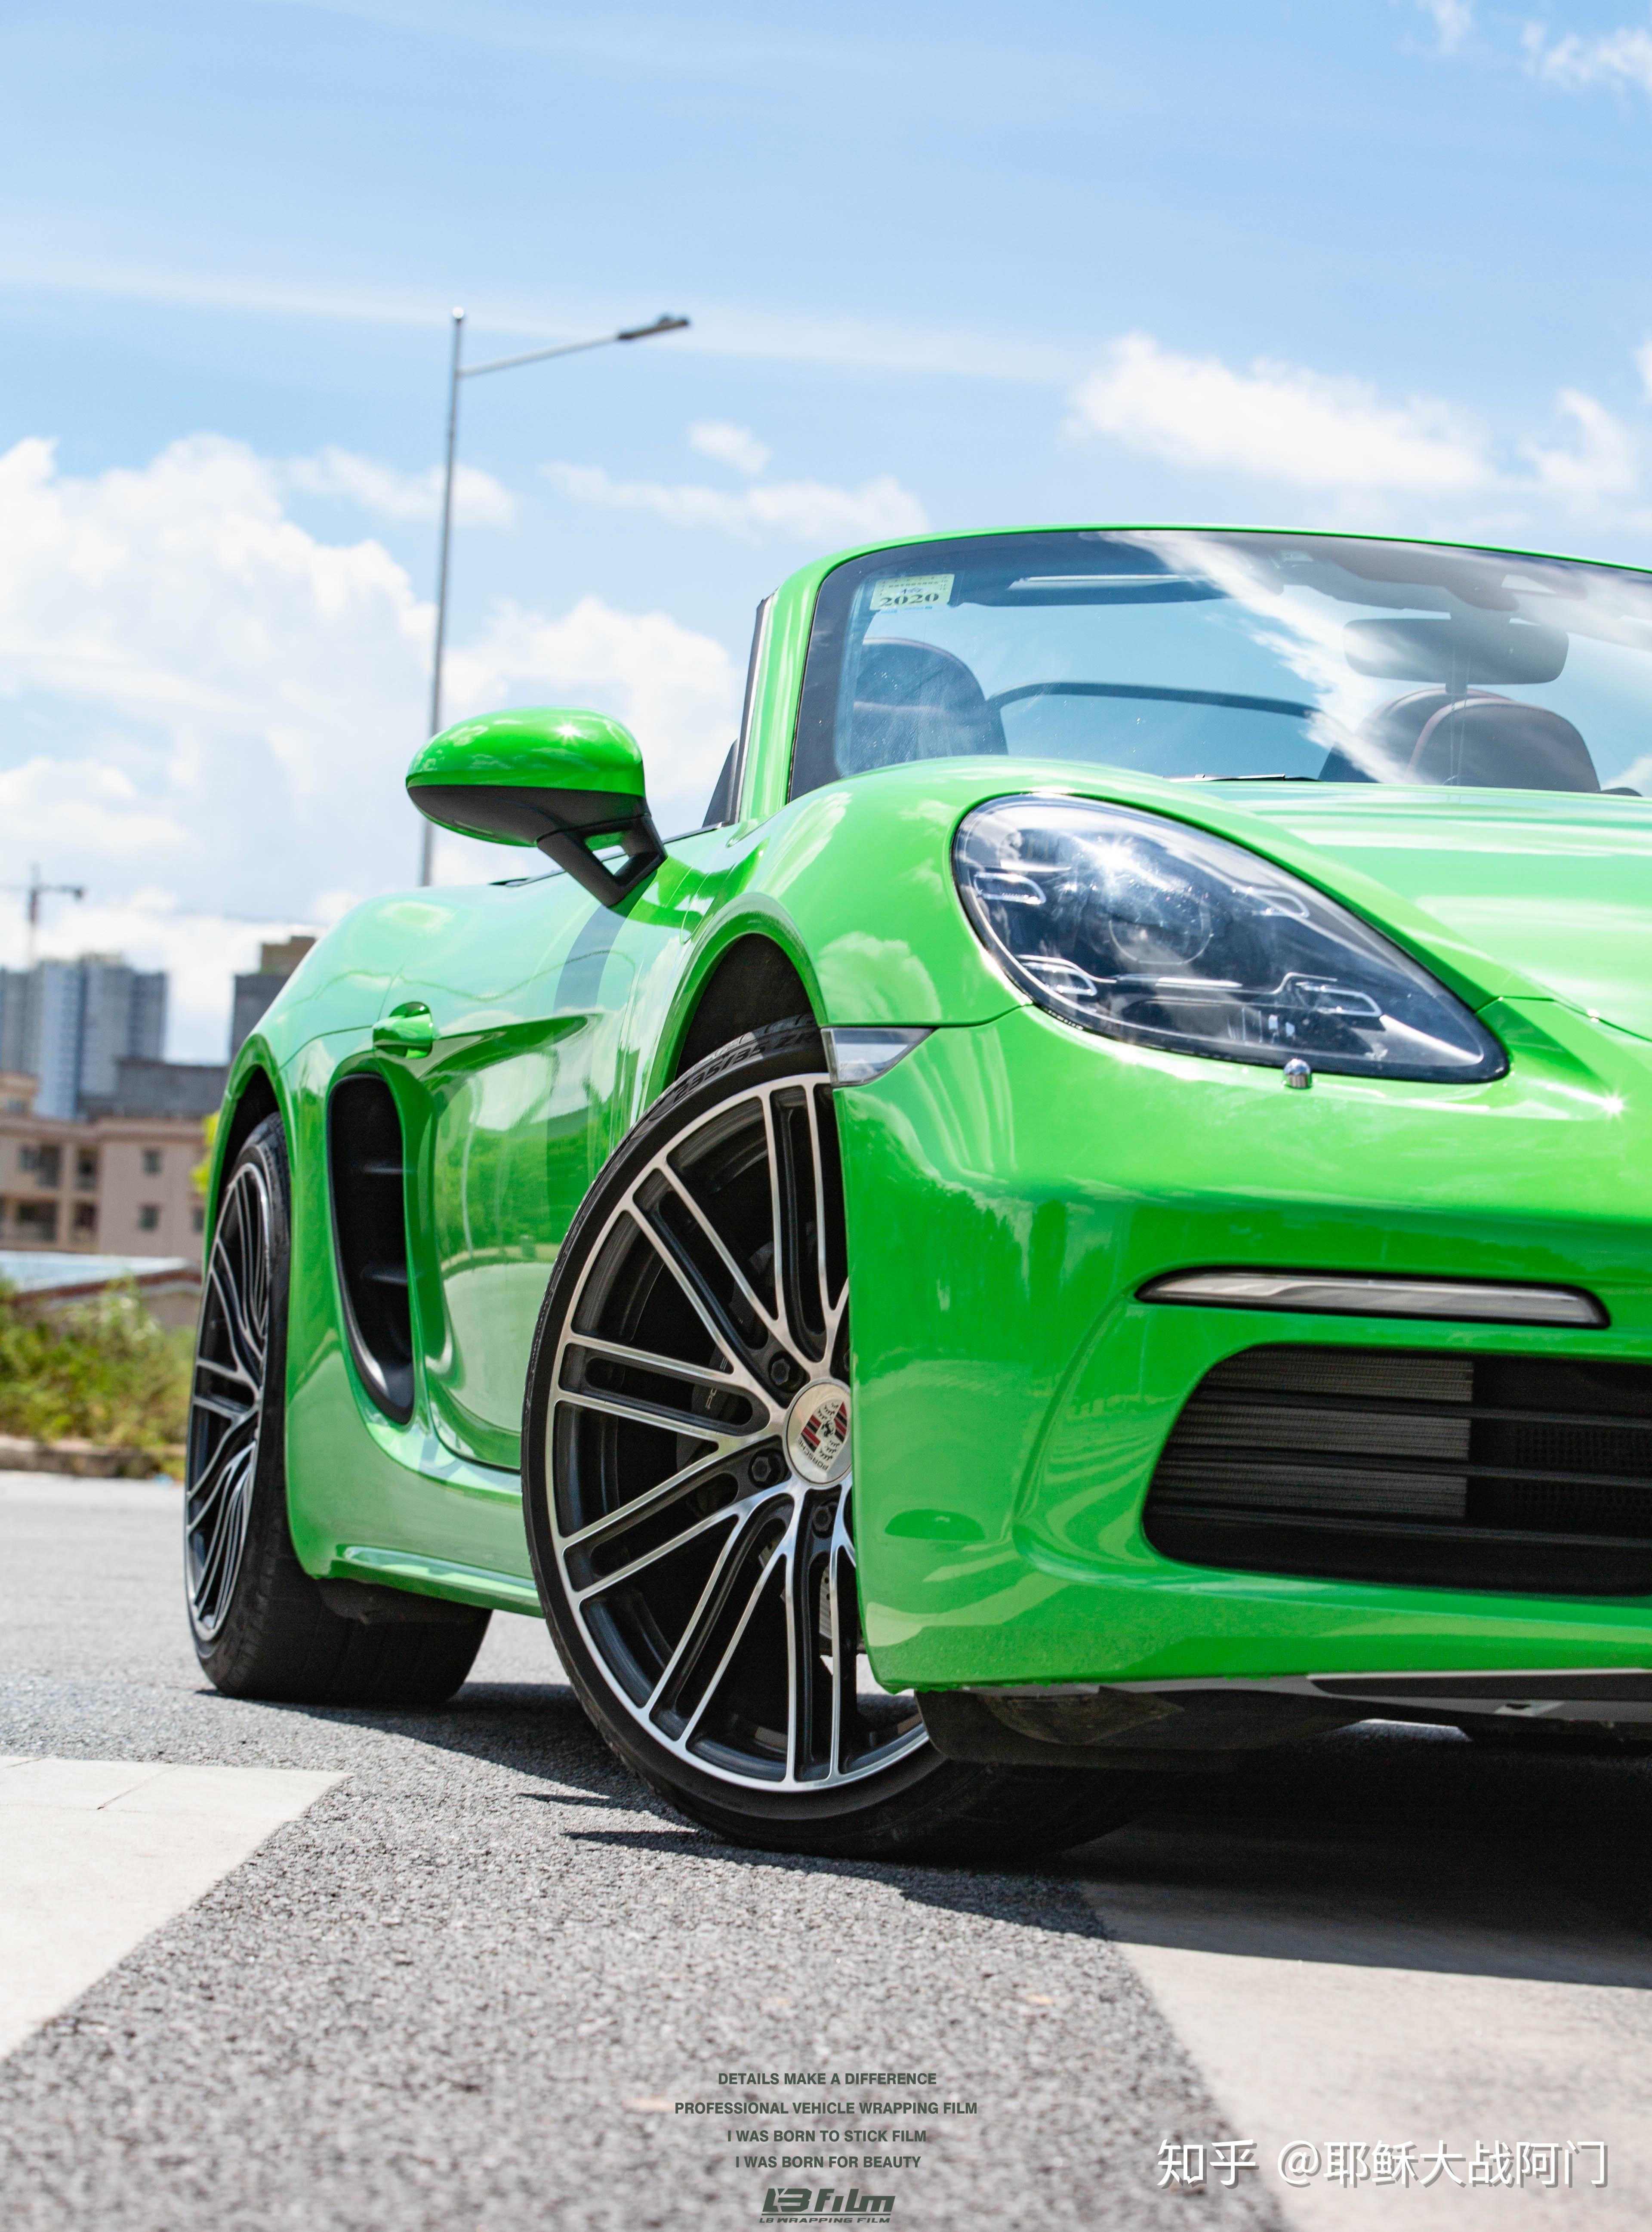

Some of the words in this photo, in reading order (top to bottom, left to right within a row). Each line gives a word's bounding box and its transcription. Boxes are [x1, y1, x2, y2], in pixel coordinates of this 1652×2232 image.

[879, 593, 939, 607] 2020
[672, 1039, 767, 1105] 235/35
[798, 1438, 829, 1471] PORSCHE
